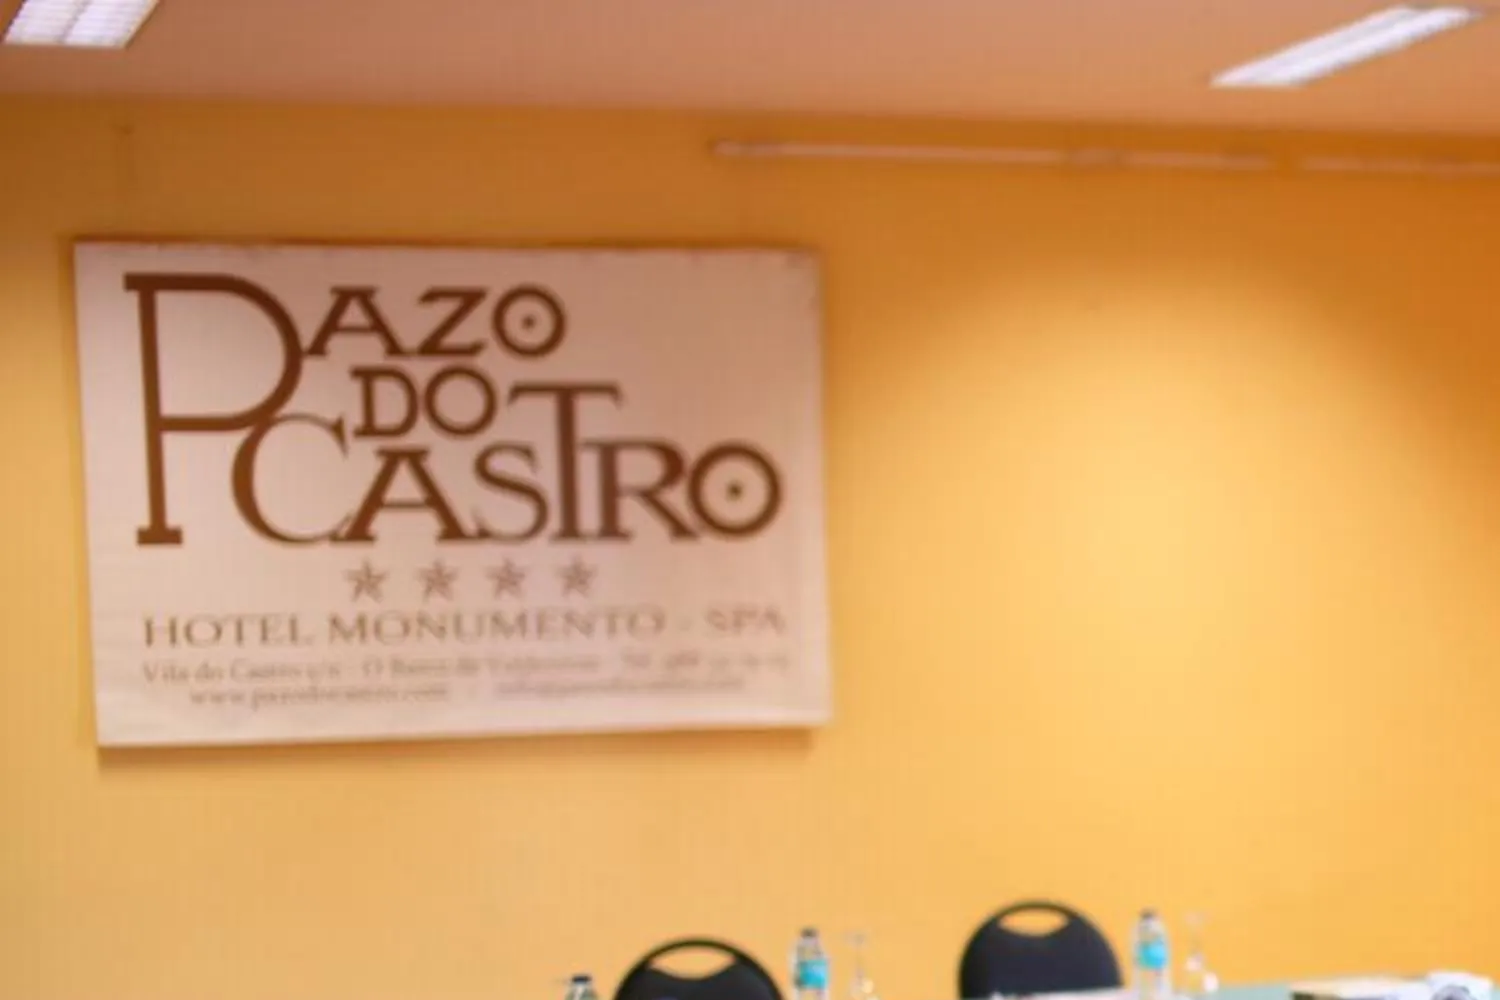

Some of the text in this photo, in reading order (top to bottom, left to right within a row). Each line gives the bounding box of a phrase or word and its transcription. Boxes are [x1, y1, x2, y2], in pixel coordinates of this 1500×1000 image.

[123, 273, 566, 545] PAZO
[351, 366, 497, 438] DO
[231, 382, 783, 544] CASTRO
[144, 613, 313, 647] HOTEL
[327, 607, 667, 645] MONUMENTO
[705, 607, 788, 634] SPA
